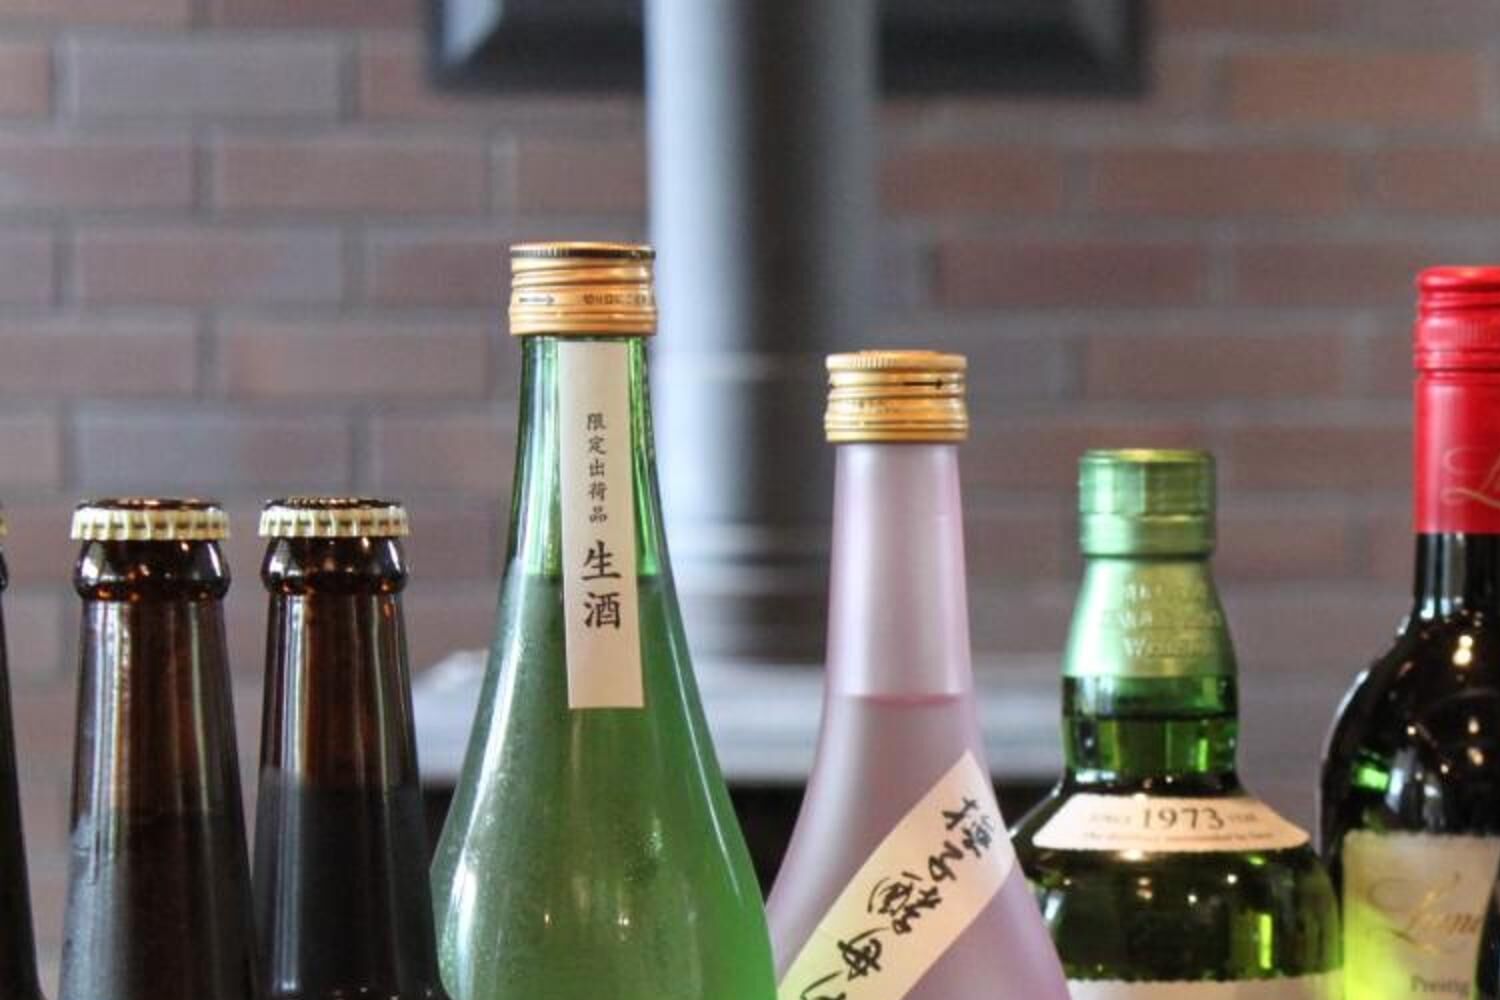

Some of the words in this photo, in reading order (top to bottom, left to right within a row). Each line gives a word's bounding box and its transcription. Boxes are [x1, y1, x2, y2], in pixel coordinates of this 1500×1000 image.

[586, 412, 608, 523] 限定出荷品
[581, 539, 622, 630] 生酒
[1143, 807, 1226, 830] 1973
